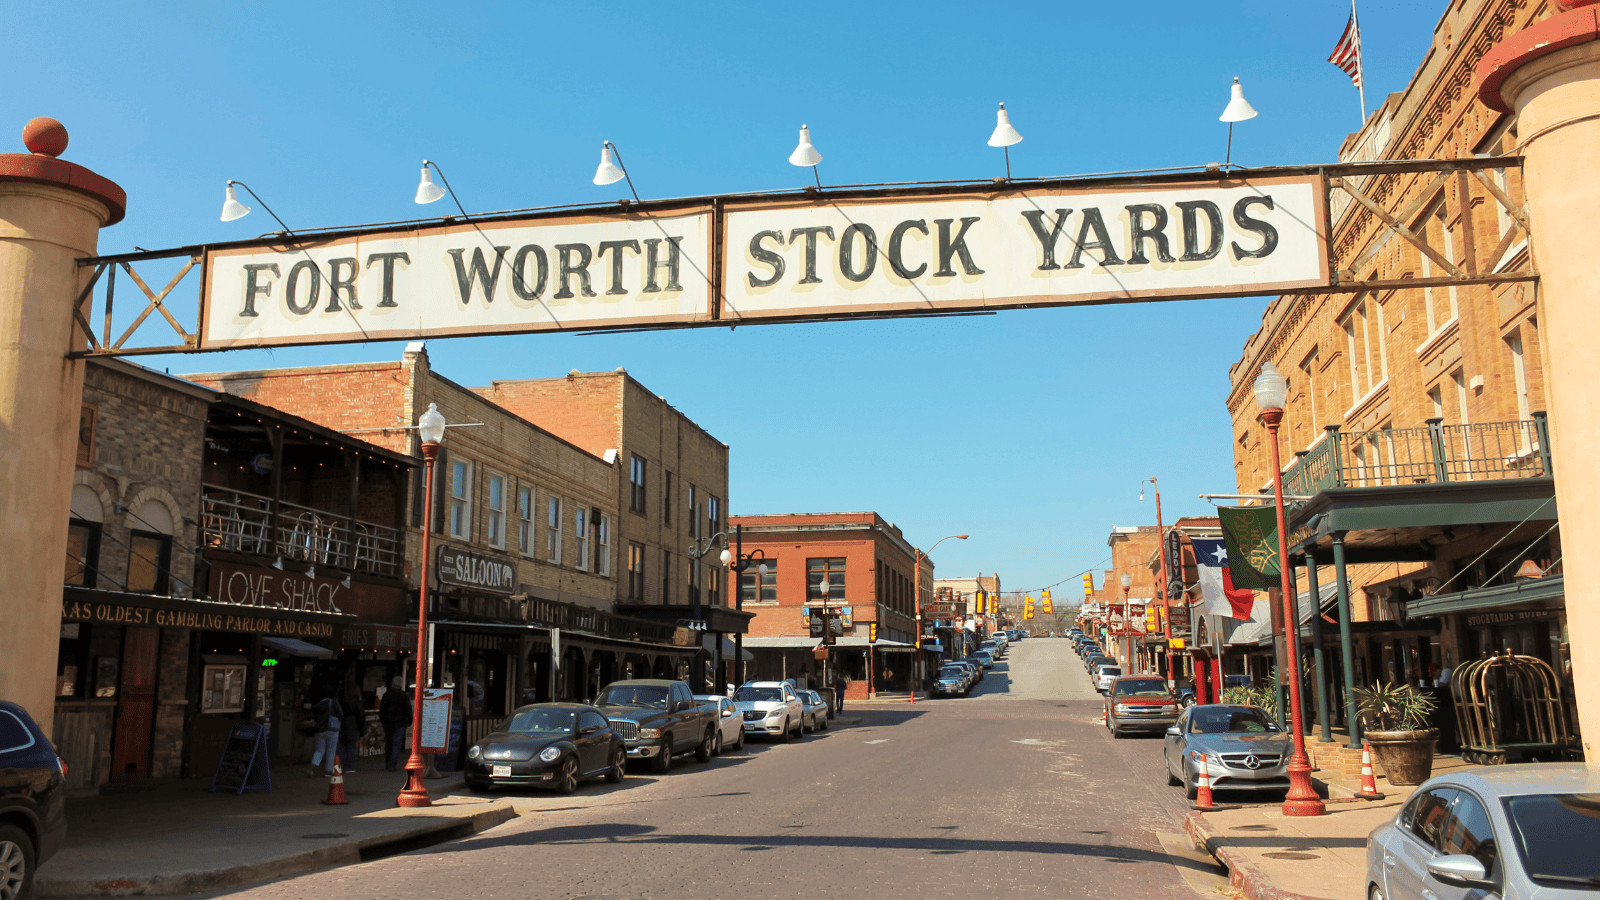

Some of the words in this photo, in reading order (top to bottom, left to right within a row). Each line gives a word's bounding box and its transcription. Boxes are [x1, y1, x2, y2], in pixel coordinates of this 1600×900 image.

[238, 251, 411, 318] FORT
[448, 235, 684, 305] WORTH
[746, 216, 985, 288] STOCK
[1021, 195, 1280, 271] YARDS
[456, 554, 502, 587] SALOON
[1171, 532, 1179, 577] LEDDY
[218, 571, 273, 606] LOVE
[281, 577, 339, 612] SHACK
[96, 603, 153, 625] OLDEST
[156, 608, 222, 630] GAMBLING
[226, 615, 270, 633] PARLOR
[273, 619, 295, 635] AND
[297, 621, 333, 637] CASINO
[1468, 613, 1514, 626] STOCKYARDS
[1519, 610, 1548, 620] HOTEL
[342, 629, 368, 647] FRIES
